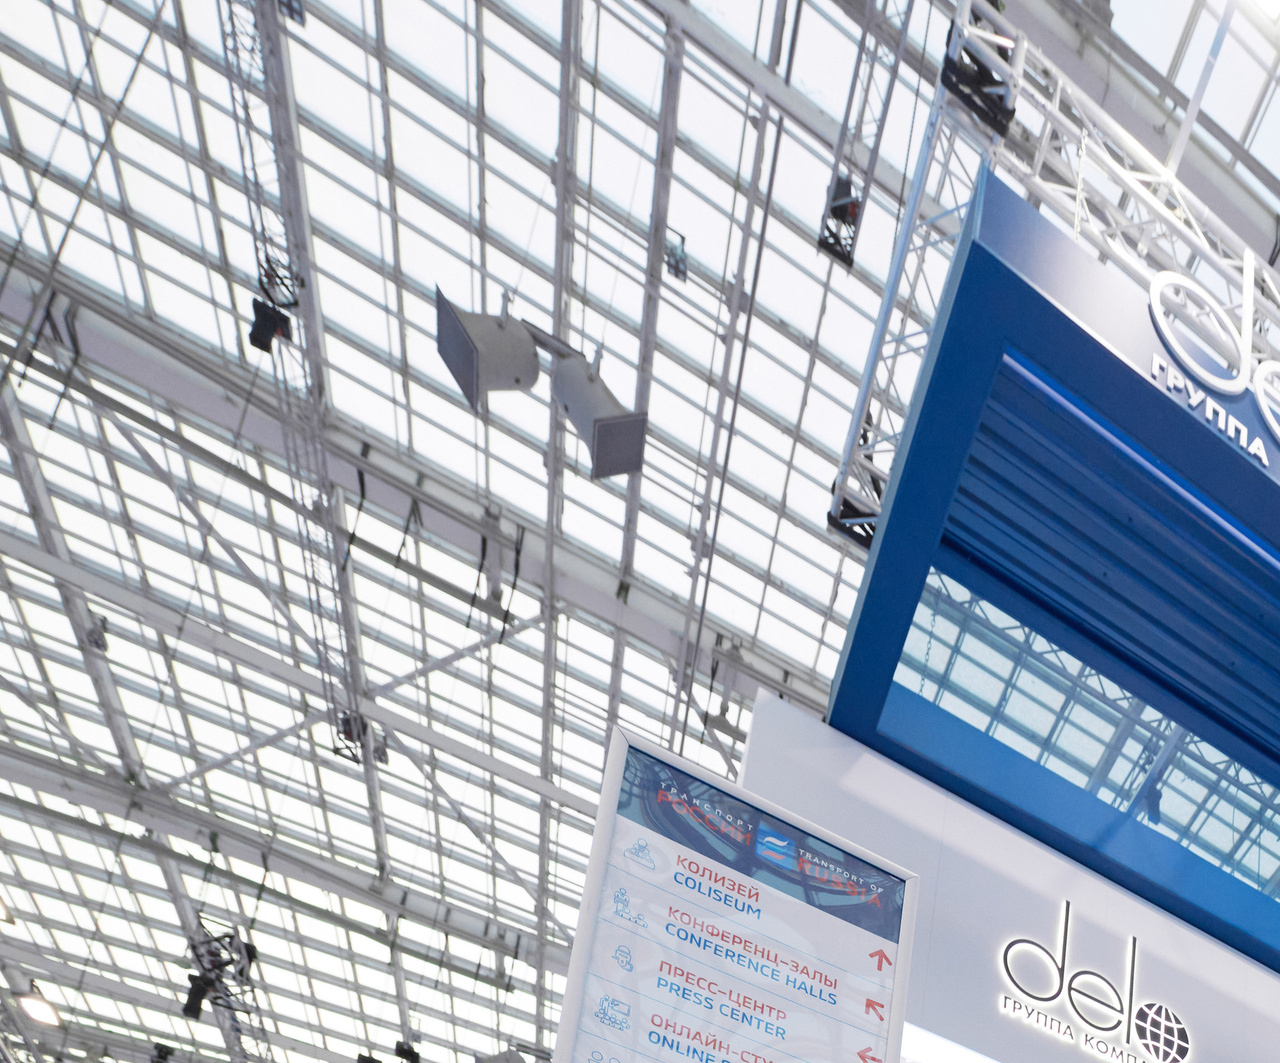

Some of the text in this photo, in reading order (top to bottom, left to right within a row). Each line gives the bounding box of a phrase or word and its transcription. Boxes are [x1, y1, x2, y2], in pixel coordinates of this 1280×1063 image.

[1151, 353, 1269, 467] ГРУППА
[657, 788, 752, 847] РОССИИ
[660, 782, 753, 831] ТРАНСПОРТ
[673, 871, 762, 920] COLISEUM
[676, 854, 760, 902] КОЛИЗЕЙ
[798, 857, 882, 909] RUSSIA
[799, 848, 884, 893] TRANSPORT OF
[665, 922, 838, 1006] CONFERENCE HALLS
[656, 976, 786, 1041] PRESS CENTER
[1003, 995, 1075, 1041] ГРУППА
